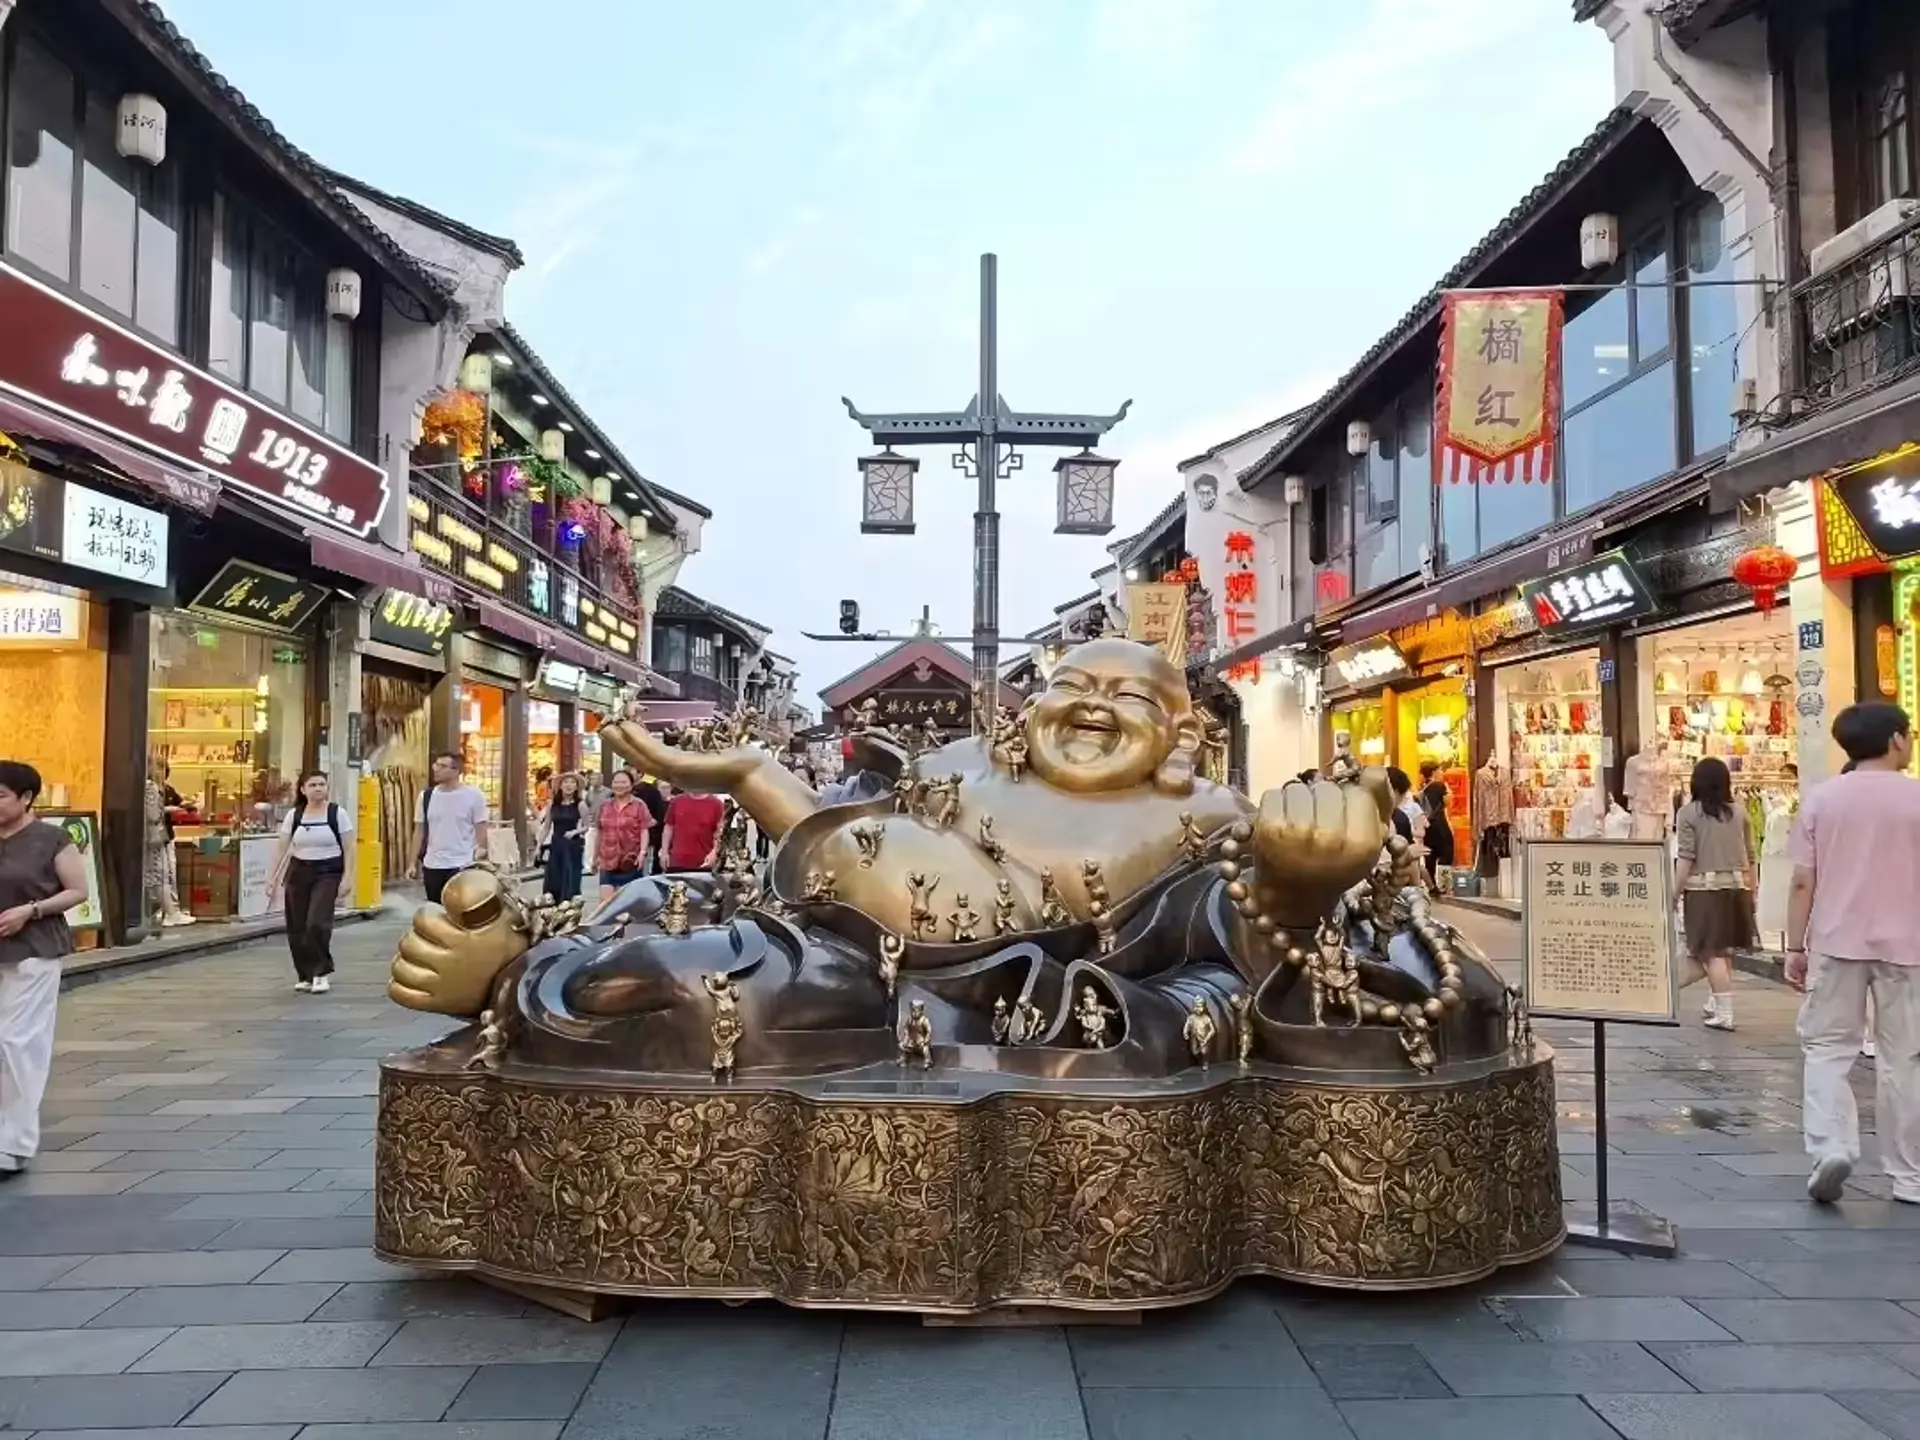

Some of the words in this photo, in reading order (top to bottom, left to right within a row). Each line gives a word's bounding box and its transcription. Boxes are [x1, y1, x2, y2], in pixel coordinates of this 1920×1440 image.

[1475, 318, 1522, 427] 橘红
[248, 428, 328, 486] 1913
[1546, 860, 1647, 878] 文明参观
[1545, 880, 1649, 900] 禁止攀爬
